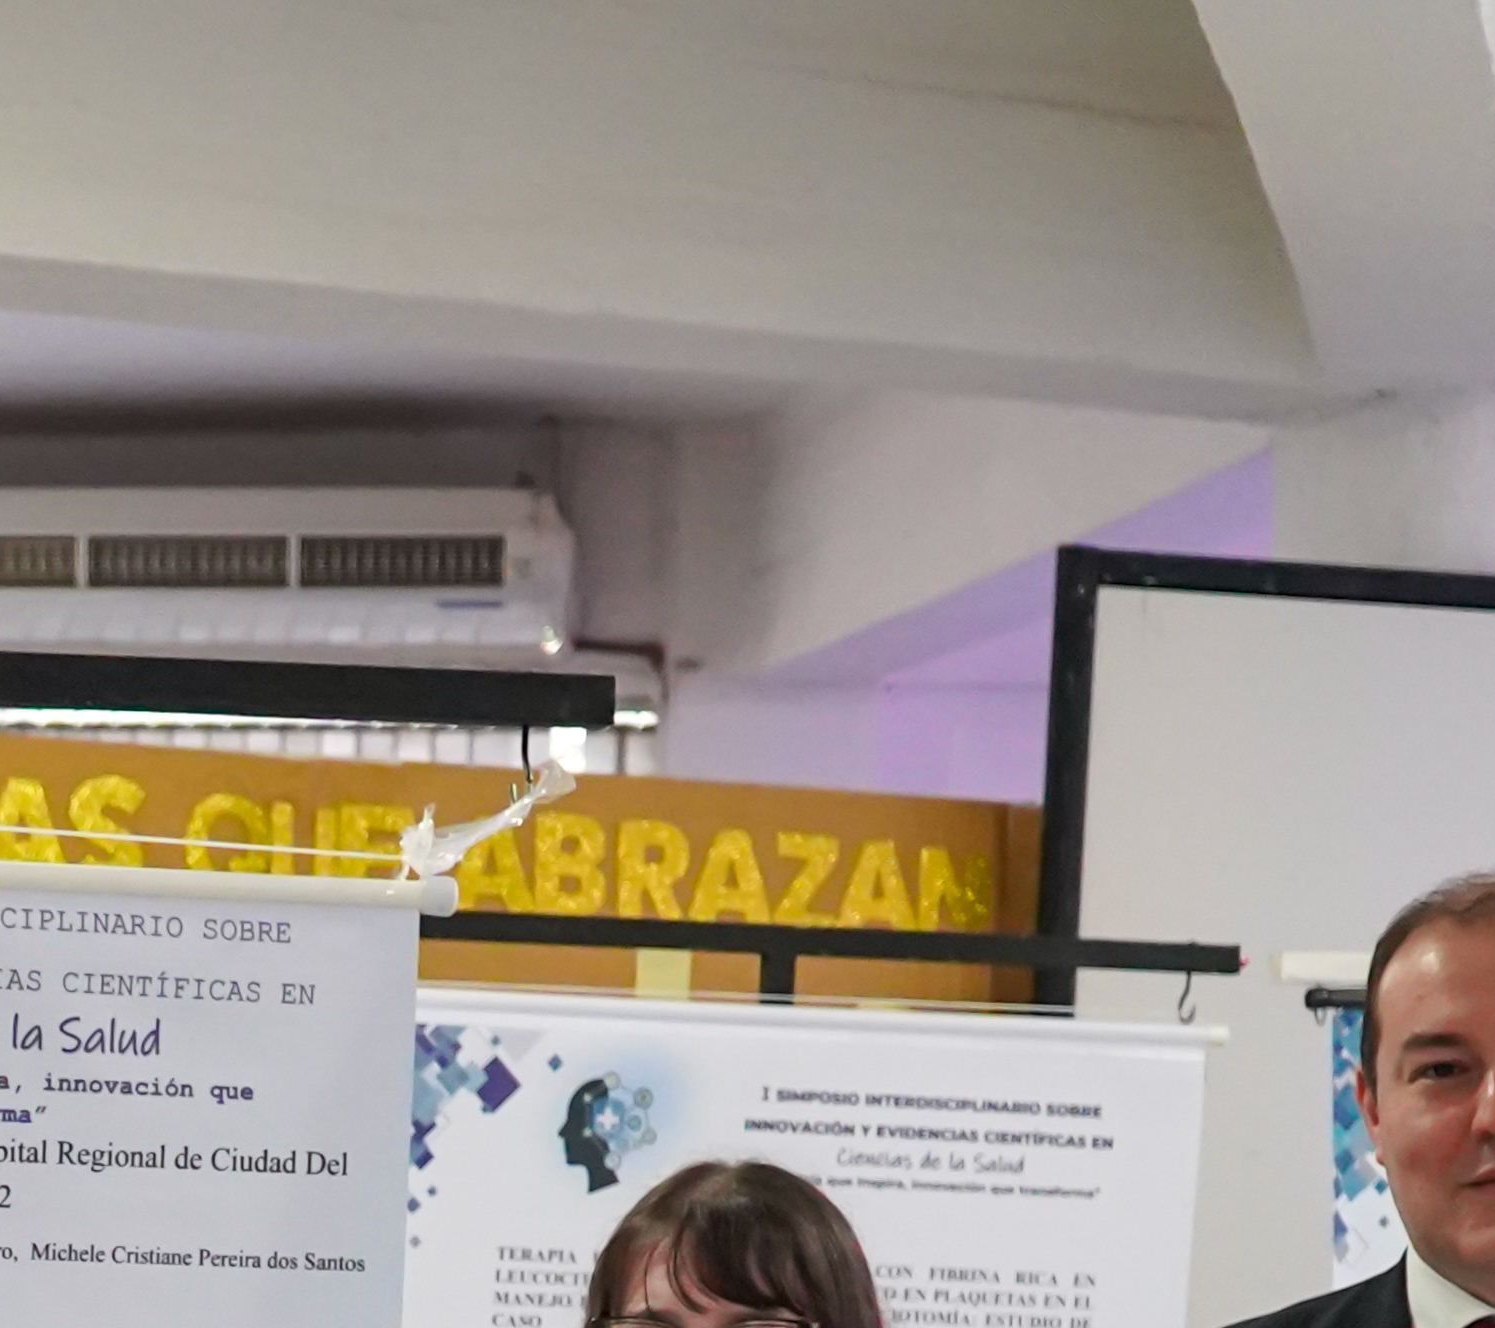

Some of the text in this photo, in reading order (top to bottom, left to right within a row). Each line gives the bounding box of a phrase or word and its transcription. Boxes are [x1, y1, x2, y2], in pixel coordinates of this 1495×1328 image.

[460, 810, 994, 933] ABRAZAN
[202, 918, 292, 944] SOBRE
[62, 970, 261, 1003] CIENTÍFICAS
[280, 982, 316, 1005] EN
[12, 1012, 43, 1051] la
[58, 1016, 161, 1057] Salud
[42, 1072, 194, 1098] innovación
[209, 1084, 254, 1105] que
[56, 1140, 166, 1173] Regional
[174, 1145, 203, 1171] de
[210, 1147, 297, 1174] Ciudad
[306, 1150, 348, 1177] Del
[30, 1242, 106, 1263] Michele
[111, 1245, 193, 1267] Cristiane
[198, 1248, 262, 1269] Pereira
[266, 1251, 298, 1270] dos
[304, 1252, 366, 1273] Santos
